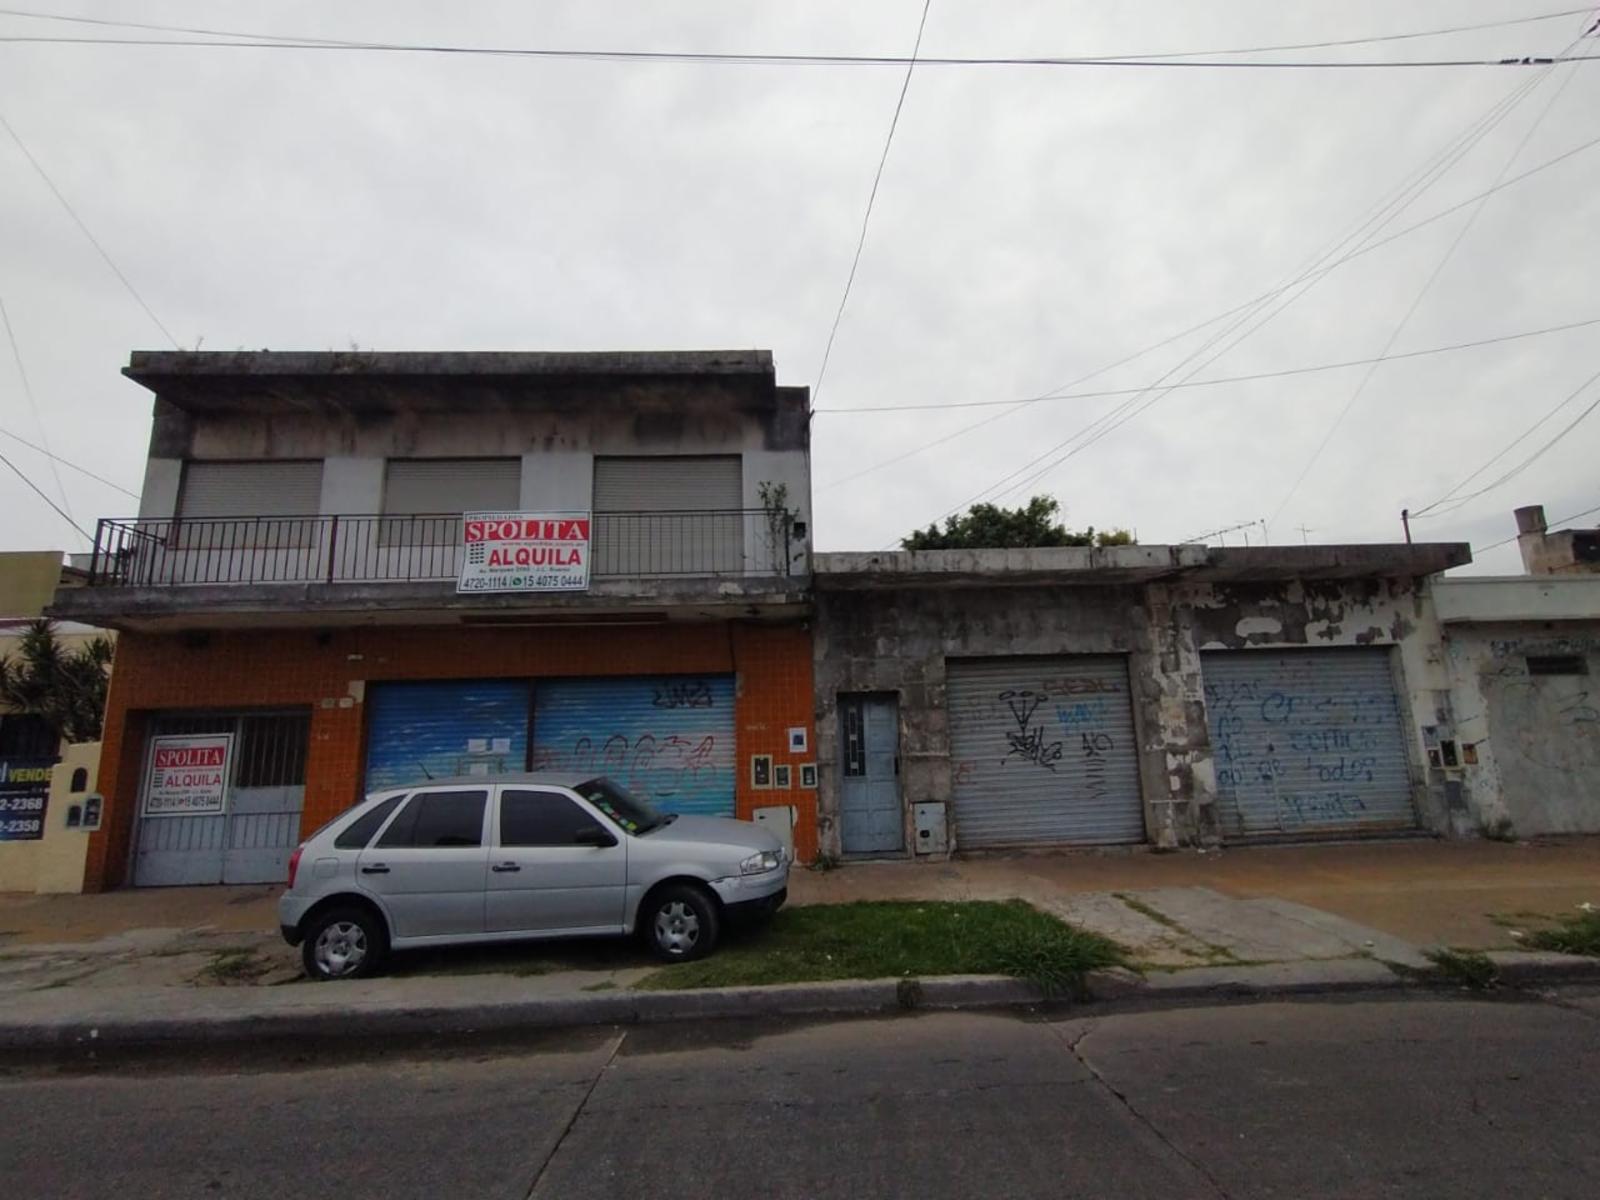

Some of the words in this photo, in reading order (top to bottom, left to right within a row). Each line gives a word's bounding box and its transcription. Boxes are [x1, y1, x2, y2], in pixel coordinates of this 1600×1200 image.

[468, 521, 585, 541] SPOLITA
[488, 548, 581, 566] ALQUILA
[463, 577, 507, 589] 4720-1114
[157, 750, 220, 766] SPOLITA
[9, 768, 53, 781] VENDE
[165, 774, 221, 788] ALQUILA
